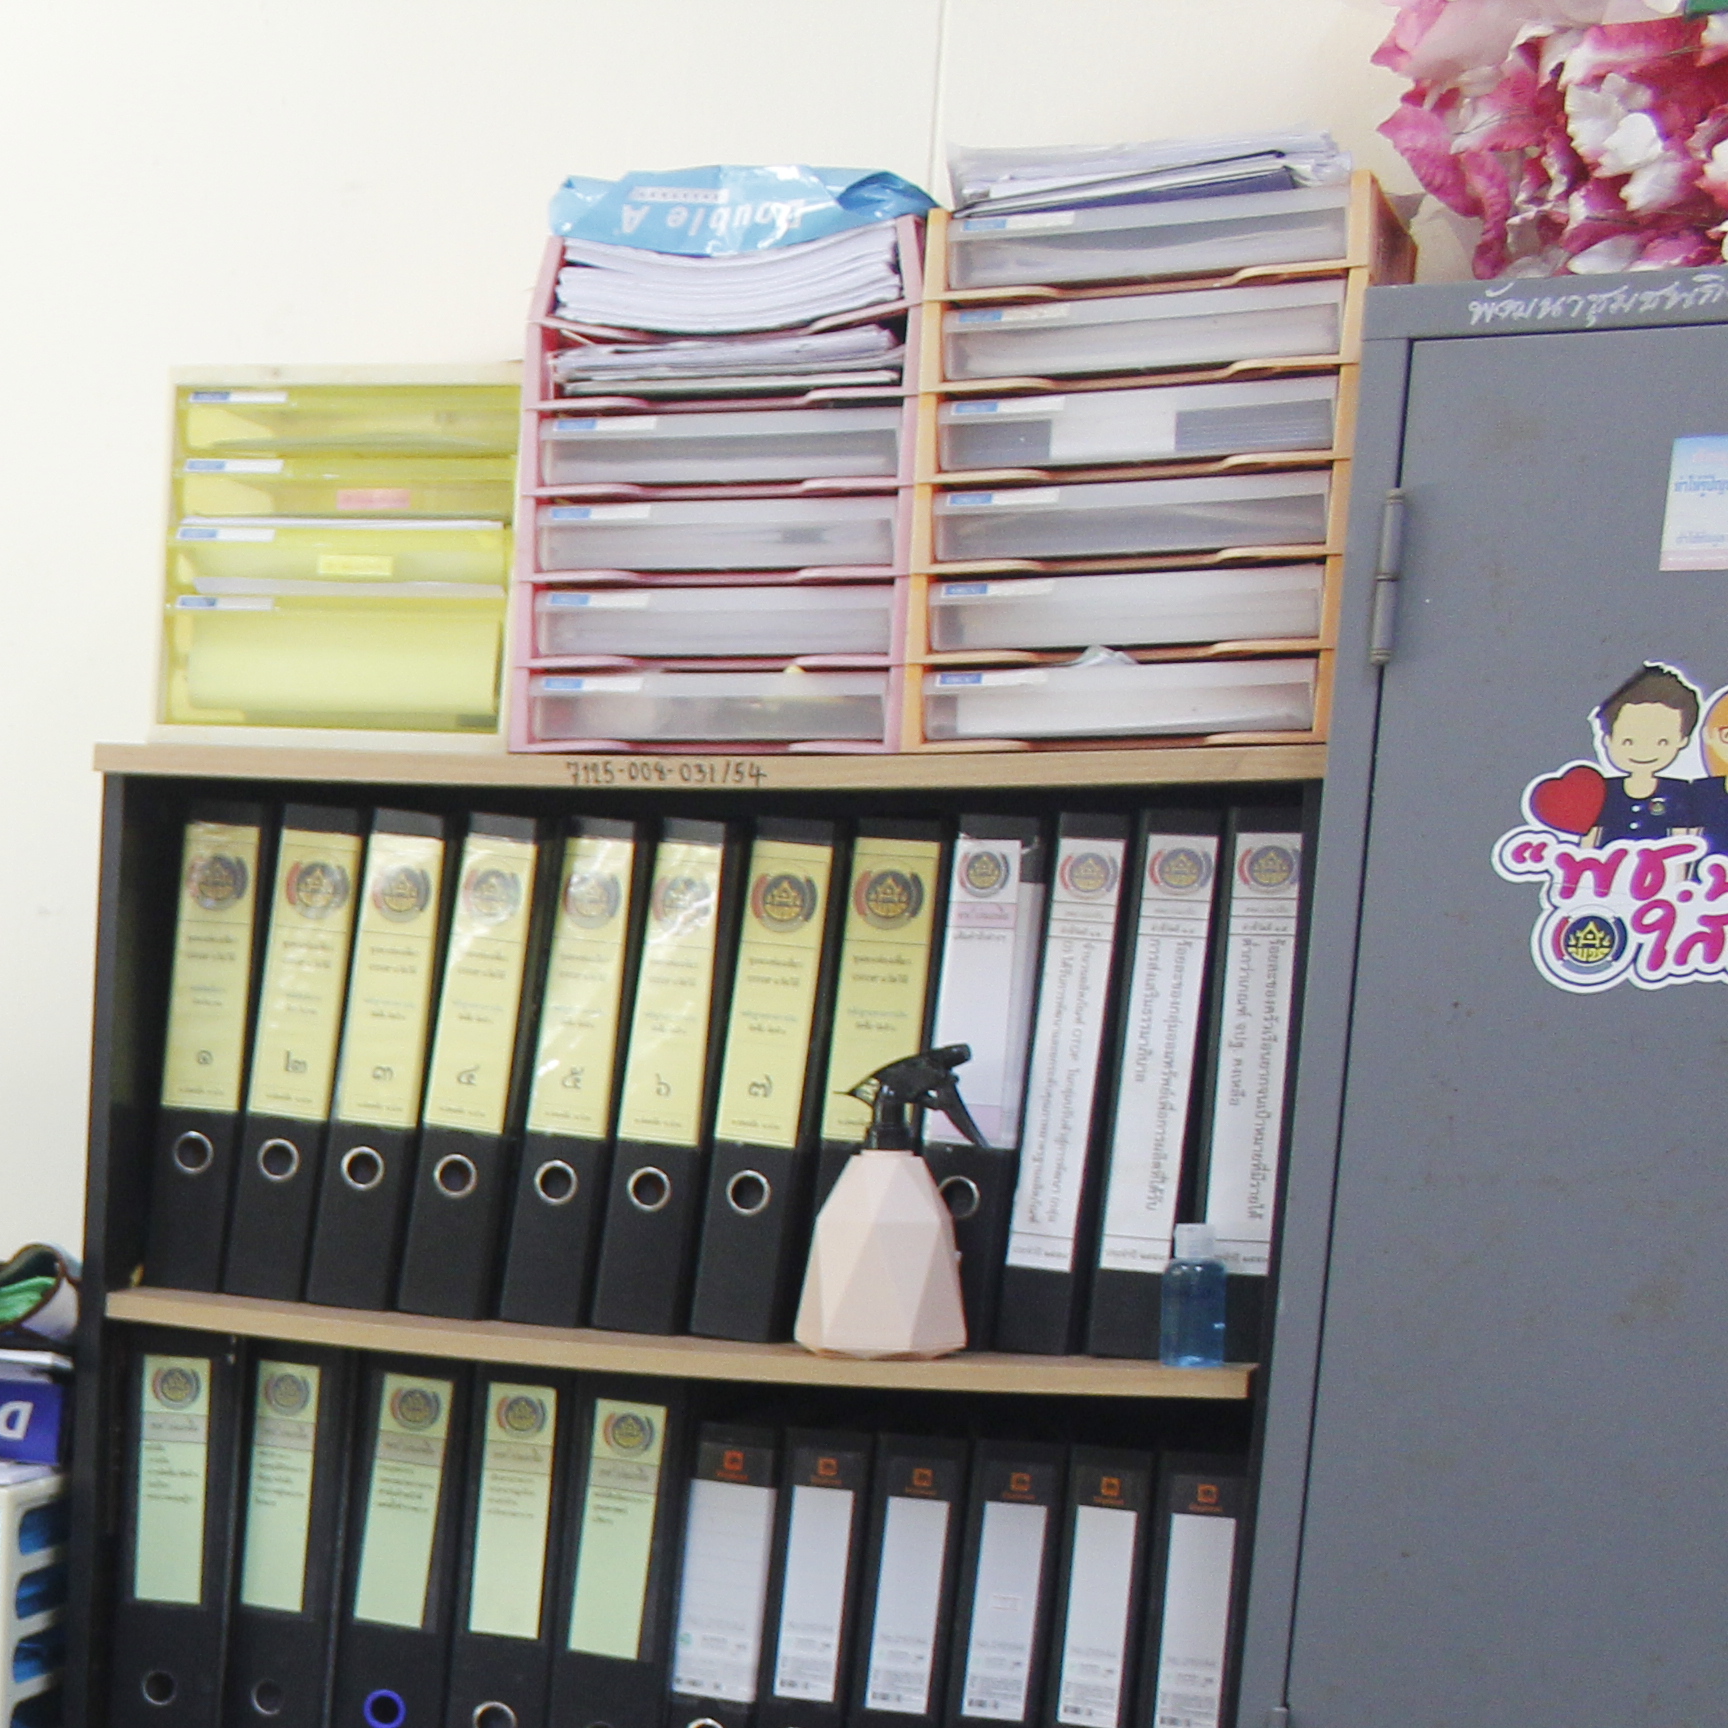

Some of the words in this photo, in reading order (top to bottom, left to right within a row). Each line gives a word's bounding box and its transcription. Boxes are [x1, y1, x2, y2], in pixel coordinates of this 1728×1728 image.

[622, 203, 651, 236] A
[197, 1049, 213, 1066] ๑
[285, 1051, 307, 1074] ๒
[372, 1065, 394, 1081] ๓
